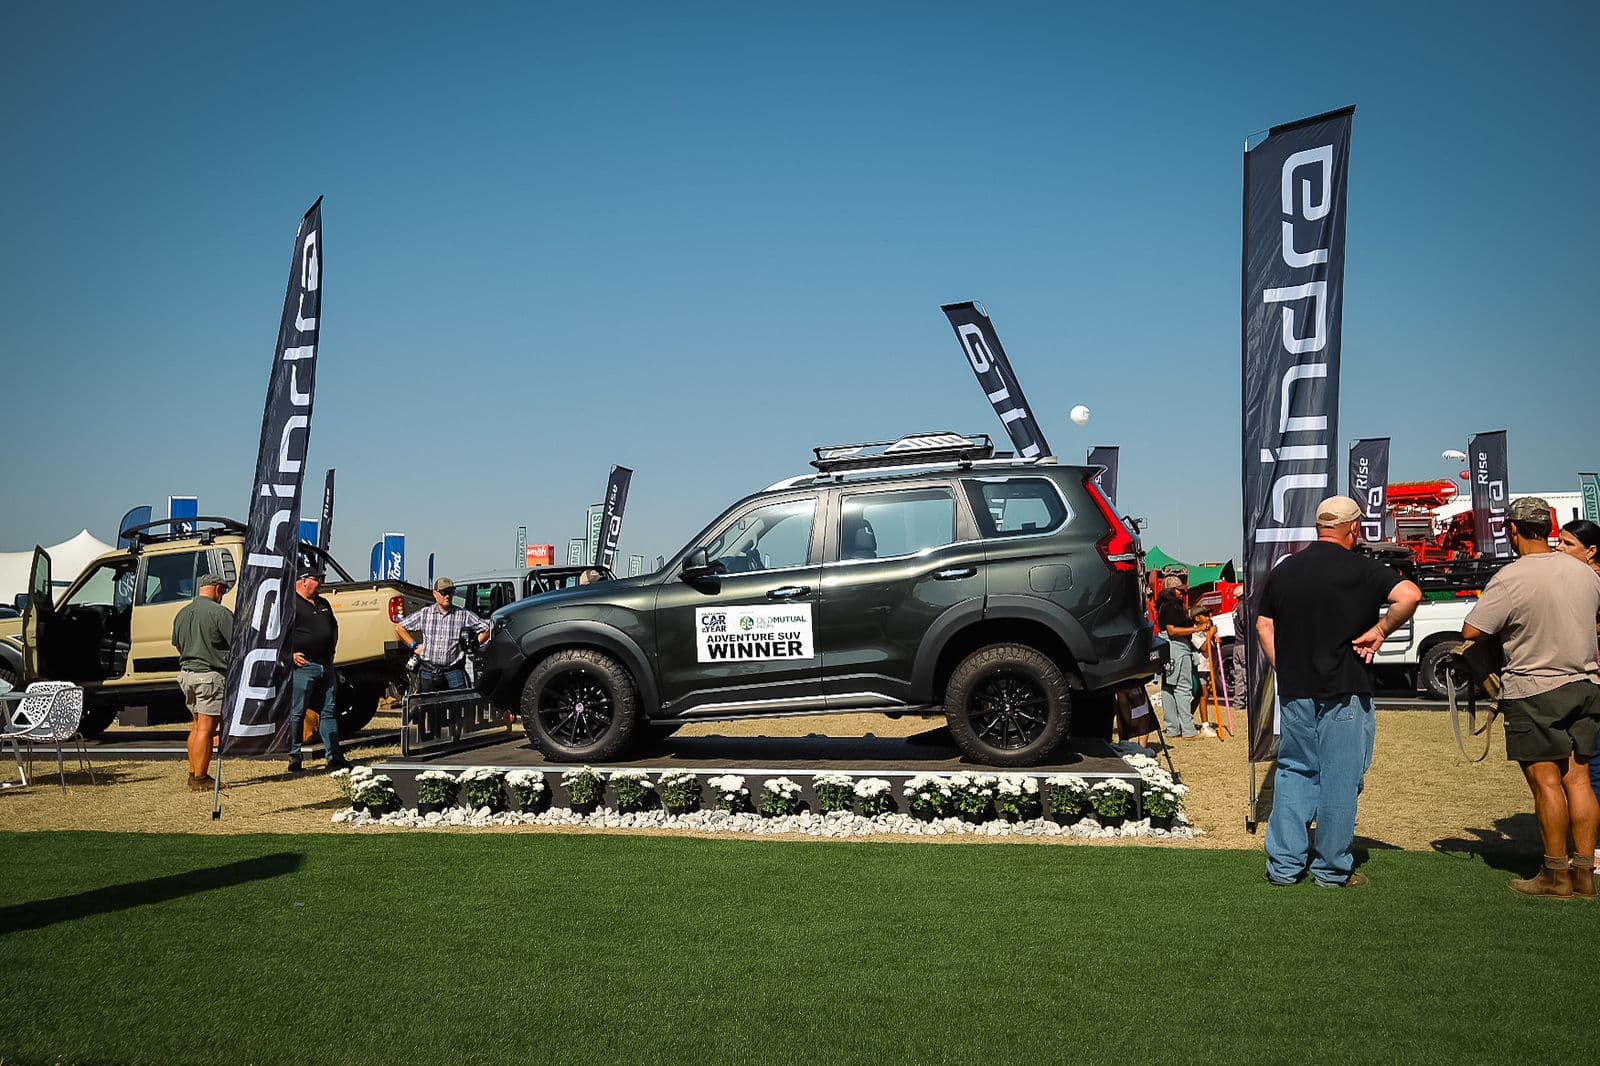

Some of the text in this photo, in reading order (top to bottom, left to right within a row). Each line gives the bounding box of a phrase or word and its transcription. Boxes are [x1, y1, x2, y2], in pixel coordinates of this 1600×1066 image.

[1355, 457, 1369, 490] Rise
[1477, 452, 1488, 485] Rise
[229, 229, 319, 738] mahindra
[701, 615, 727, 626] CAR
[706, 632, 801, 643] ADVENTURE SUV
[707, 641, 803, 660] WINNER
